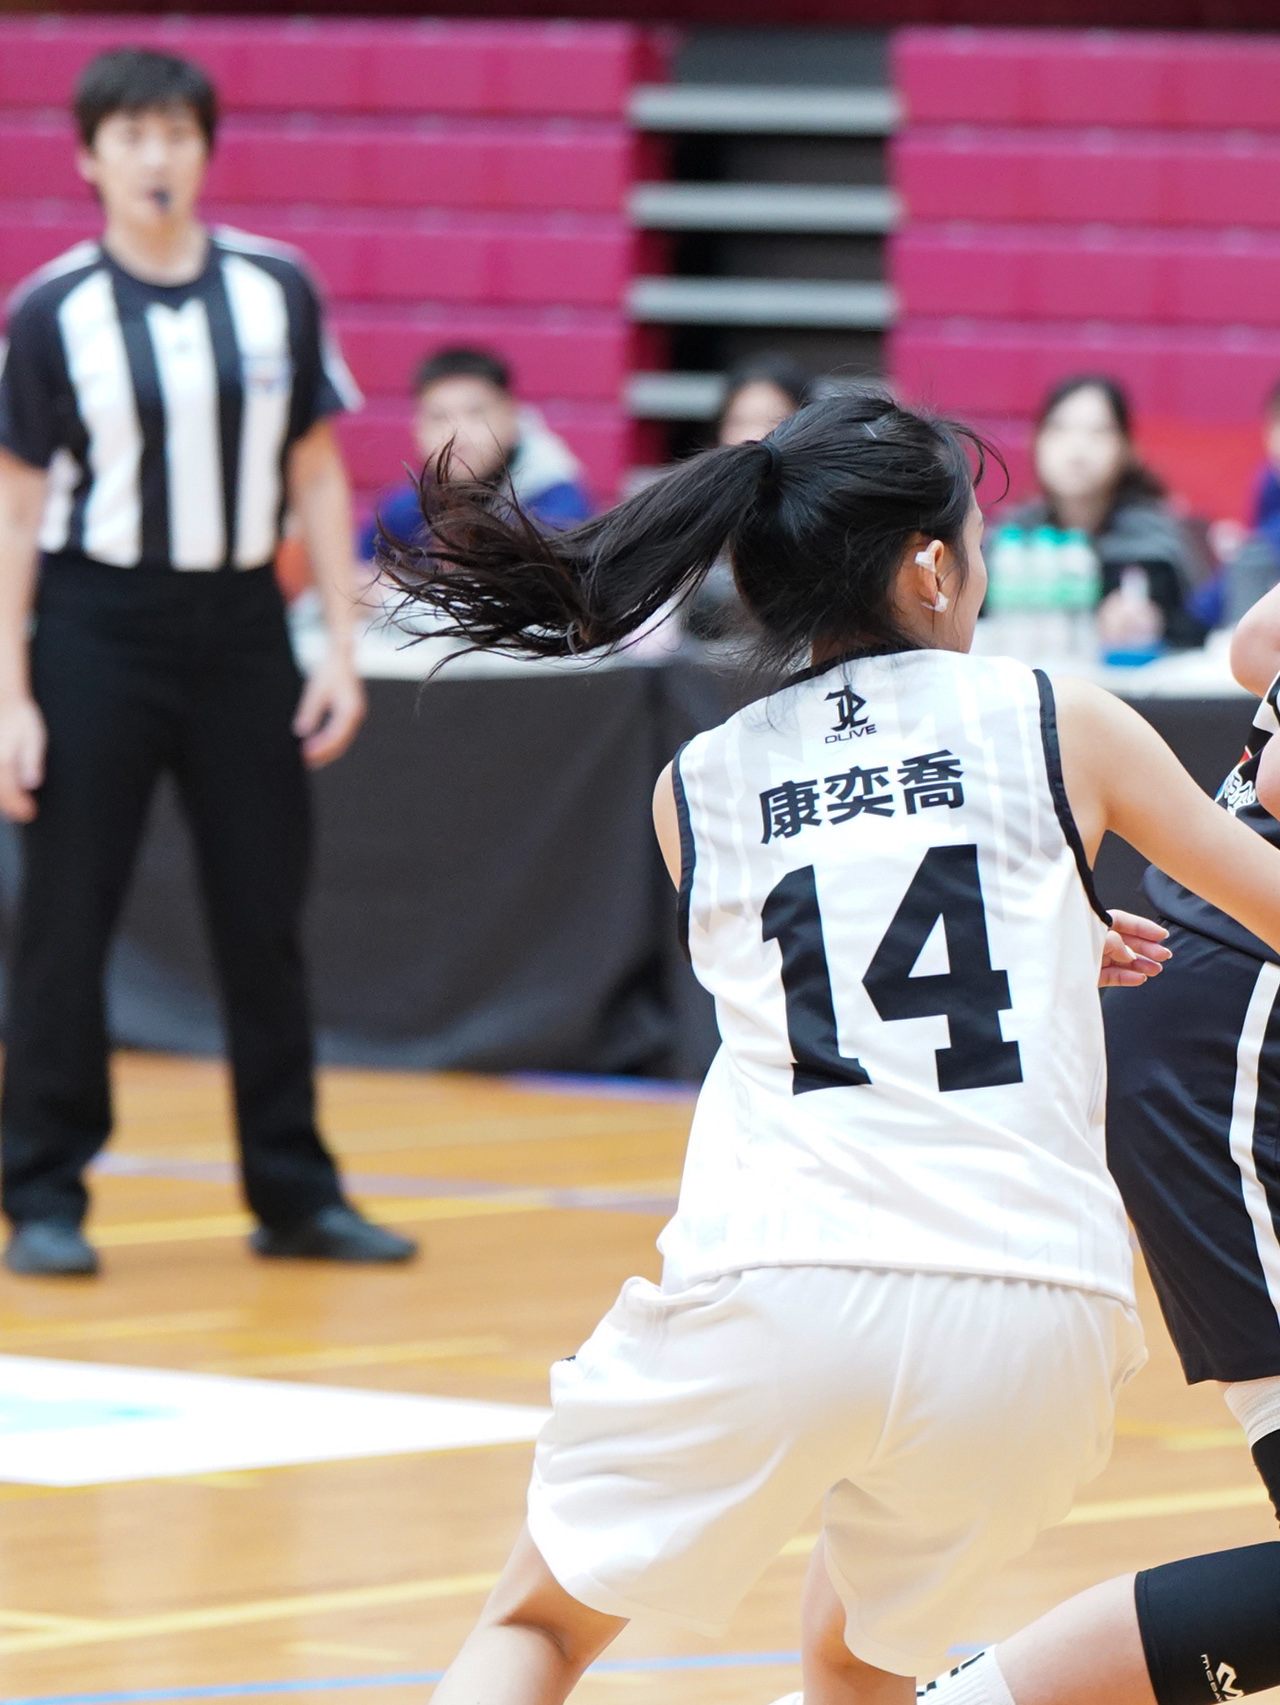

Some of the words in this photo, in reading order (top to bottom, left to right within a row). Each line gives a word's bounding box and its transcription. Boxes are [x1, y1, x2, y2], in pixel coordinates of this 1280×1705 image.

[825, 723, 877, 744] OLIVE
[758, 749, 966, 845] 康奕喬
[760, 843, 1024, 1096] 14
